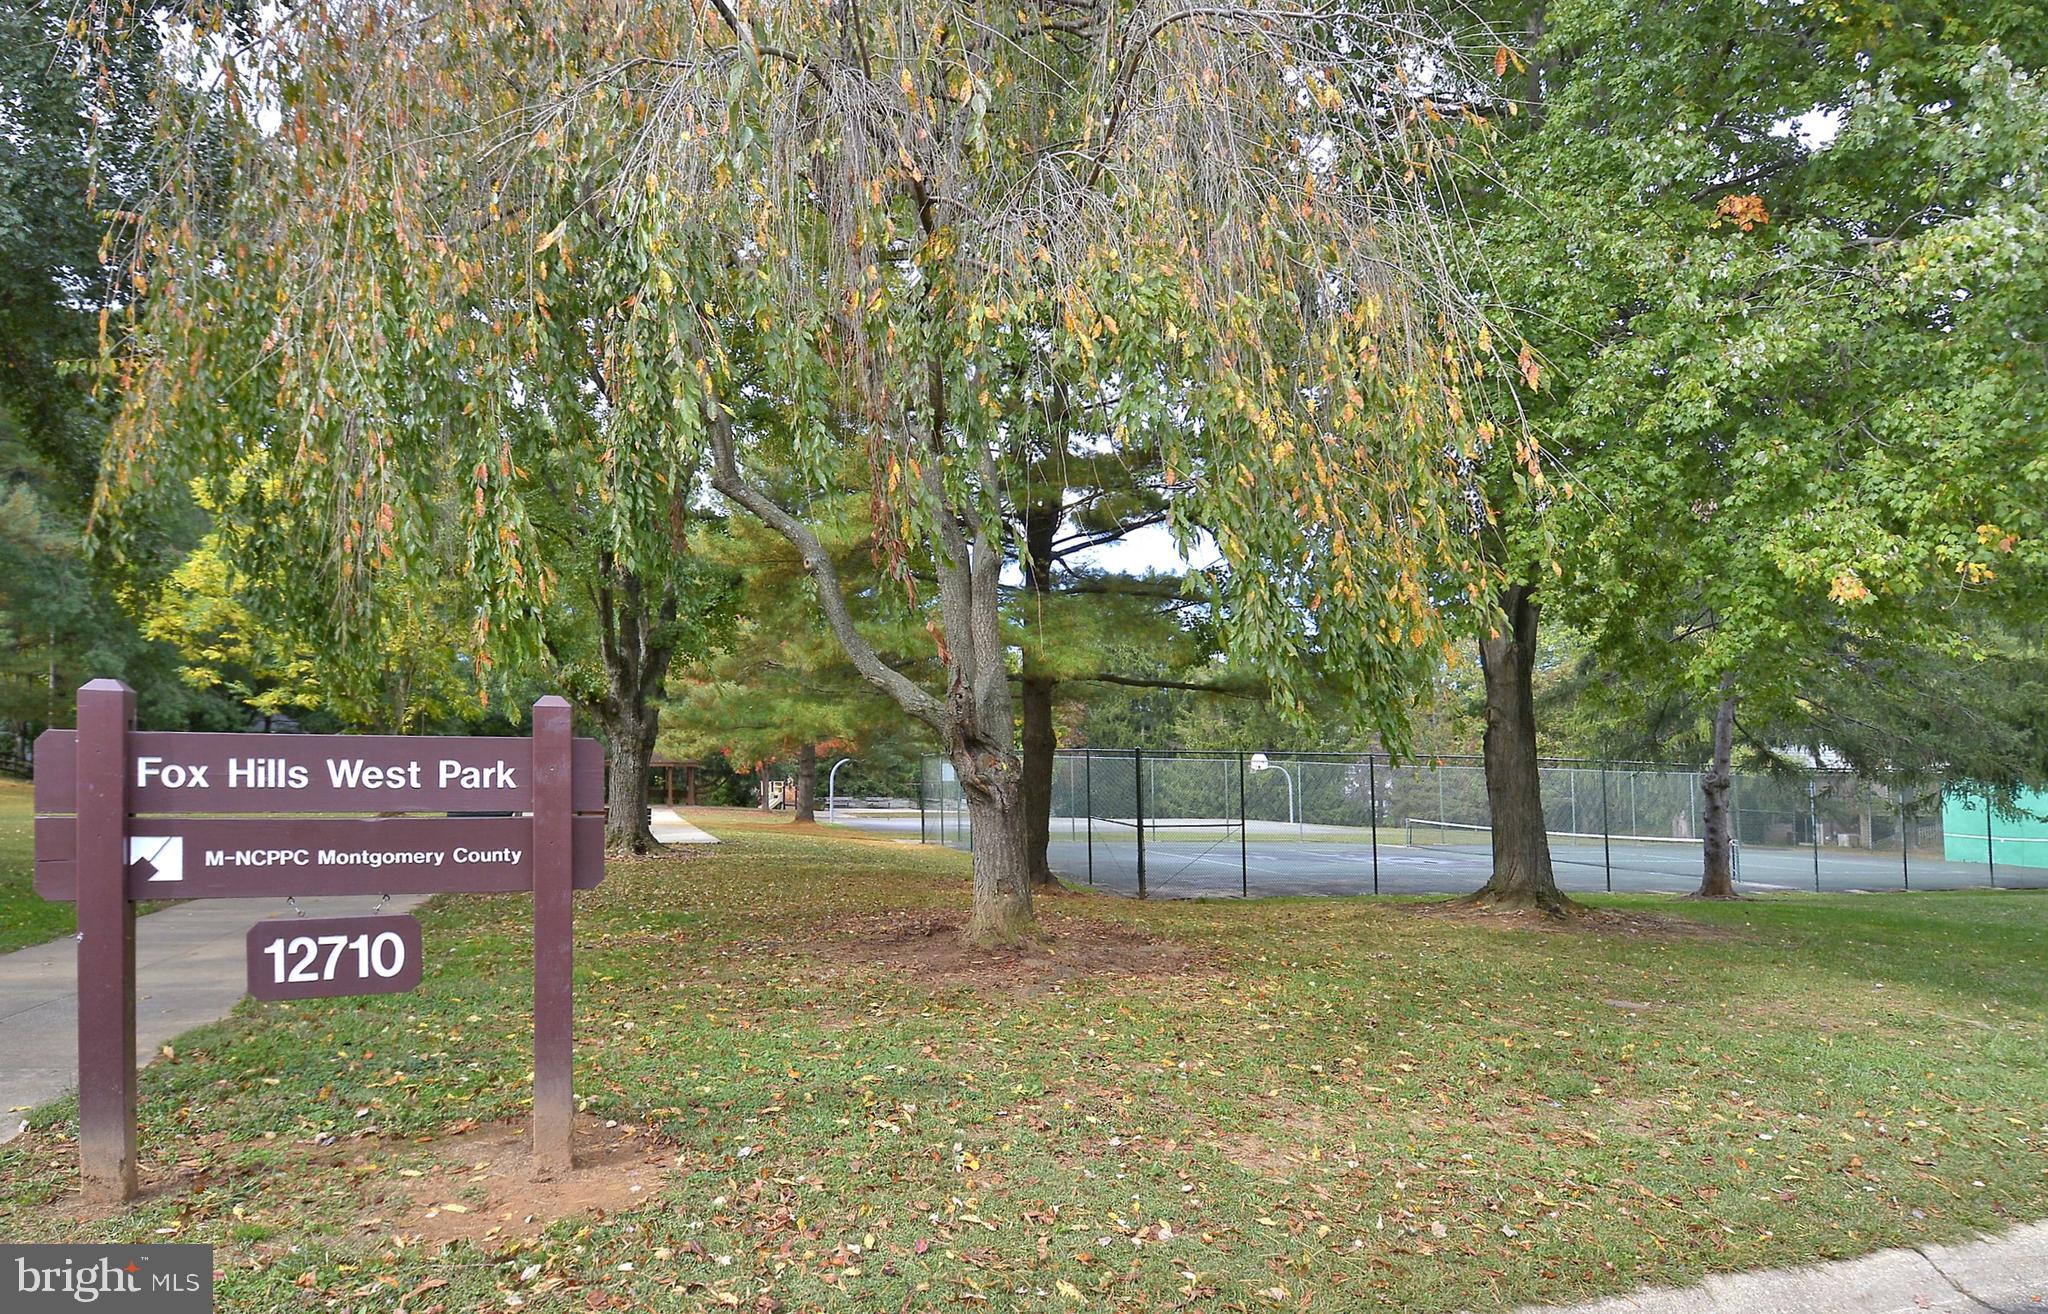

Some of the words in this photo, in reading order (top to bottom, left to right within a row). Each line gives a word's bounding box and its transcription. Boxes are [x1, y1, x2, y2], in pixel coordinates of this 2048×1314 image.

[138, 756, 210, 788] Fox
[228, 757, 309, 788] Hills
[327, 759, 422, 789] West
[439, 760, 518, 789] Park
[205, 849, 310, 867] M-NCPPC
[317, 849, 445, 868] Montgomery
[453, 847, 522, 865] County
[264, 931, 405, 984] 12710
